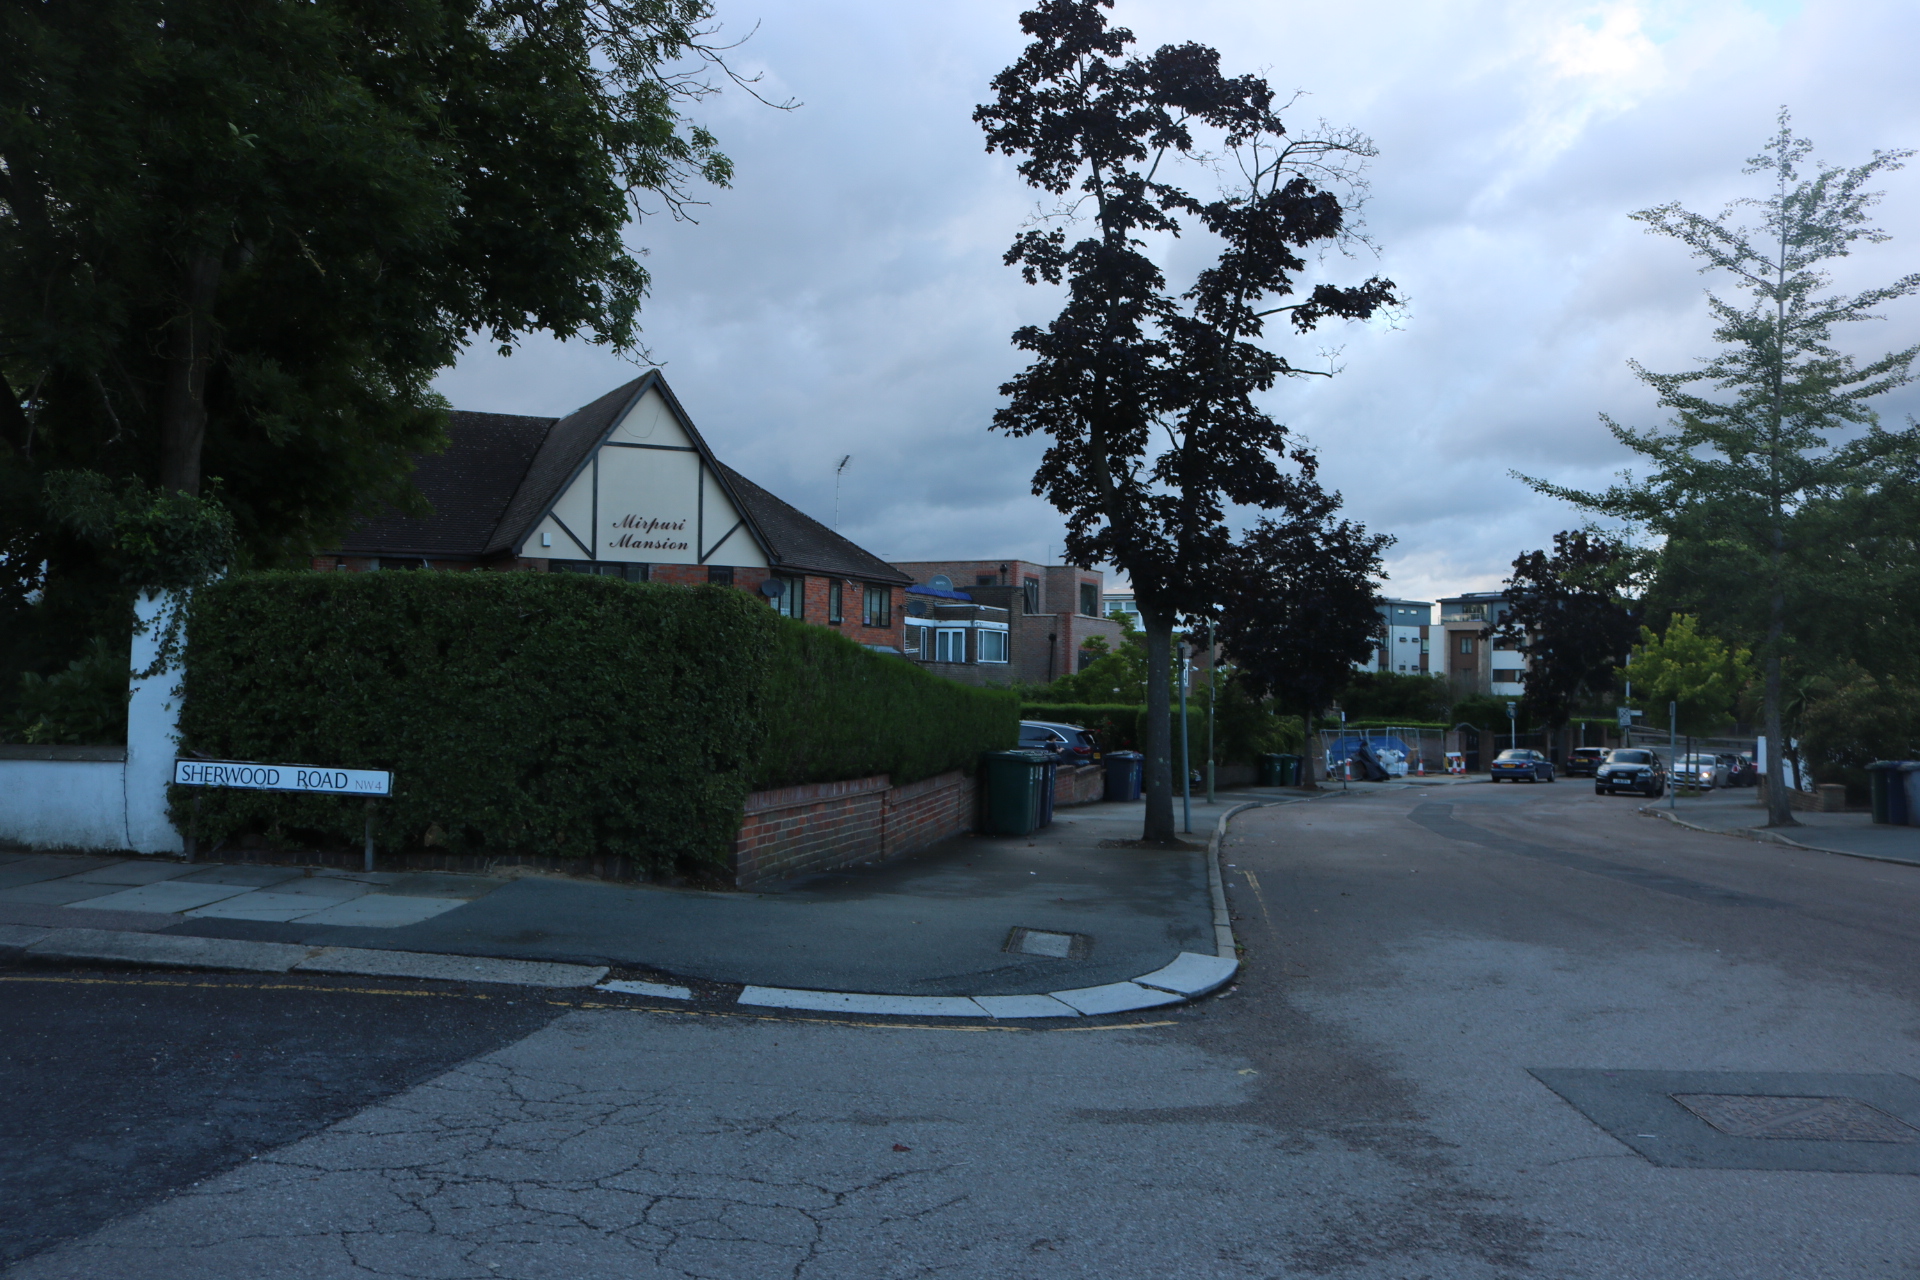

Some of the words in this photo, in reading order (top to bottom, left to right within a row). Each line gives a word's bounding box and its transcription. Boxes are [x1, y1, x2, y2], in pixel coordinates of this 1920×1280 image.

[612, 513, 686, 534] Mirpuri
[609, 534, 688, 550] Mansion
[181, 765, 279, 785] SHERWOOD
[297, 771, 347, 789] ROAD
